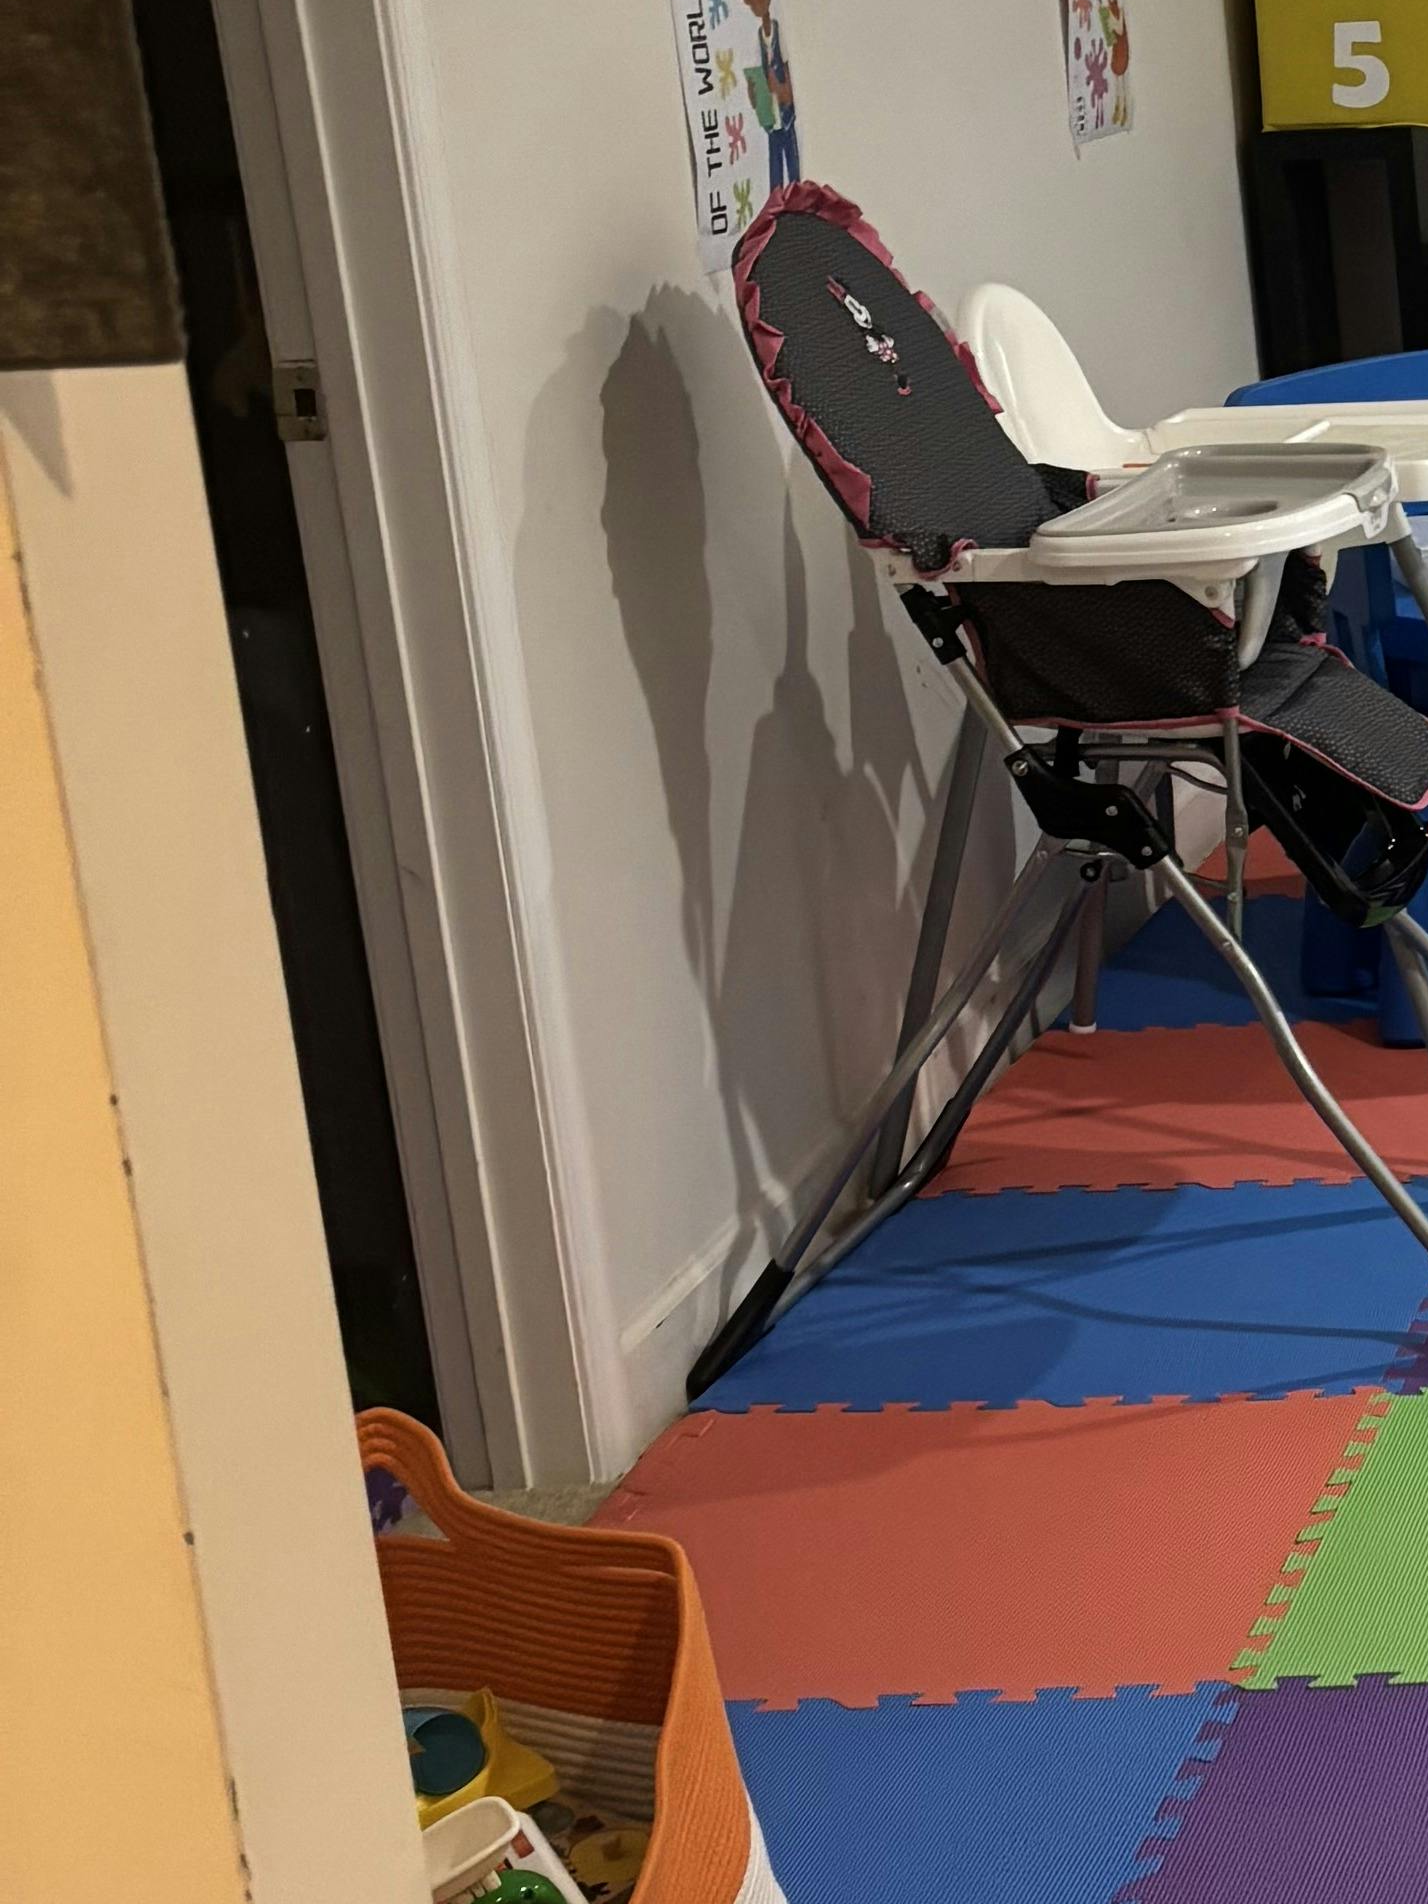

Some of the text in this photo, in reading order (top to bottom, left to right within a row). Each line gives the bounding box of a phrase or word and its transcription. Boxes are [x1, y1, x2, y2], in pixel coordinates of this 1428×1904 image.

[1331, 20, 1391, 109] 5
[701, 109, 720, 177] THE
[709, 191, 729, 236] OF
